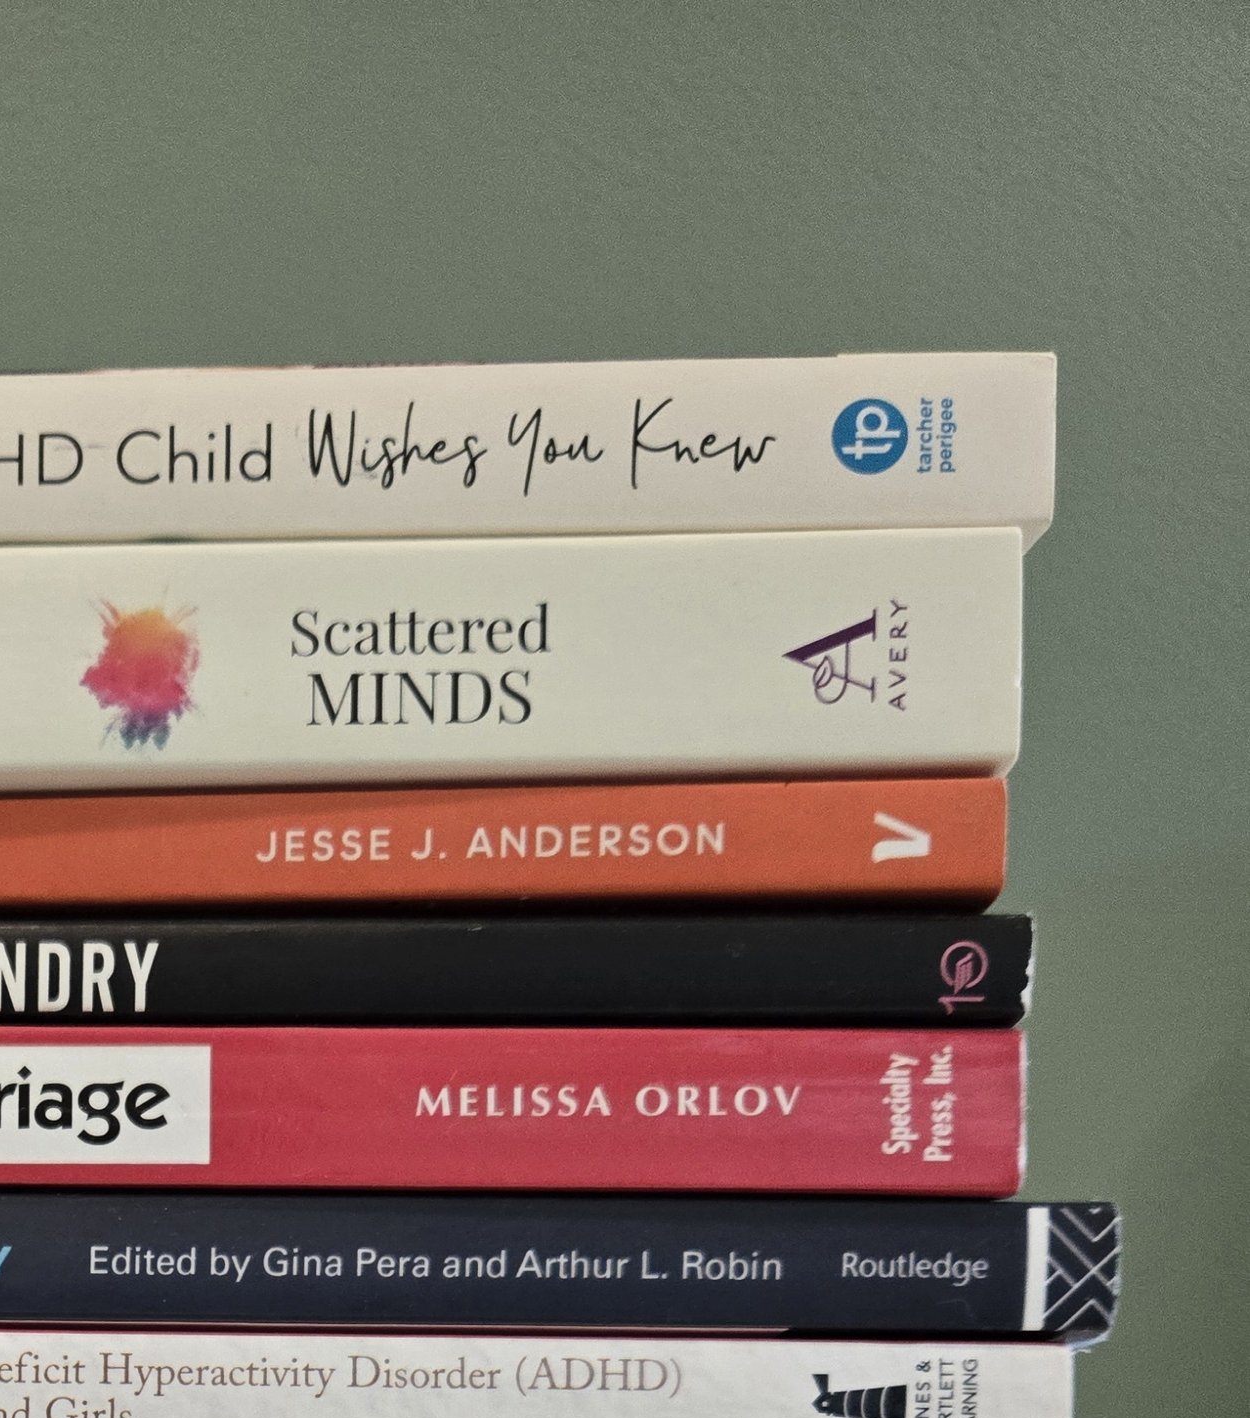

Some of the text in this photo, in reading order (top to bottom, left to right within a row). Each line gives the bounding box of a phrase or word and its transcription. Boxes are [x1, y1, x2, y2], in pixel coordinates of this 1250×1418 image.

[117, 423, 271, 484] Child
[309, 402, 487, 489] Wishes
[508, 408, 603, 496] You
[632, 399, 775, 489] Knew
[841, 406, 901, 460] tp
[916, 398, 932, 473] tarcher
[936, 399, 957, 472] perigee
[292, 603, 547, 656] Scattered
[888, 599, 908, 712] AVERY
[308, 671, 531, 725] MINDS
[256, 823, 724, 862] JESSE J. ANDERSON
[416, 1086, 800, 1116] MELISSA ORLOV
[880, 1053, 919, 1154] Specialty
[923, 1044, 957, 1161] Press, Inc.
[90, 1246, 782, 1282] Edited by Gina Pera and Arthur L. Robin
[842, 1252, 988, 1286] Routledge
[99, 1353, 335, 1398] Hyperactivity
[348, 1356, 501, 1389] Disorder
[516, 1357, 681, 1398] (ADHD)
[915, 1360, 931, 1372] &
